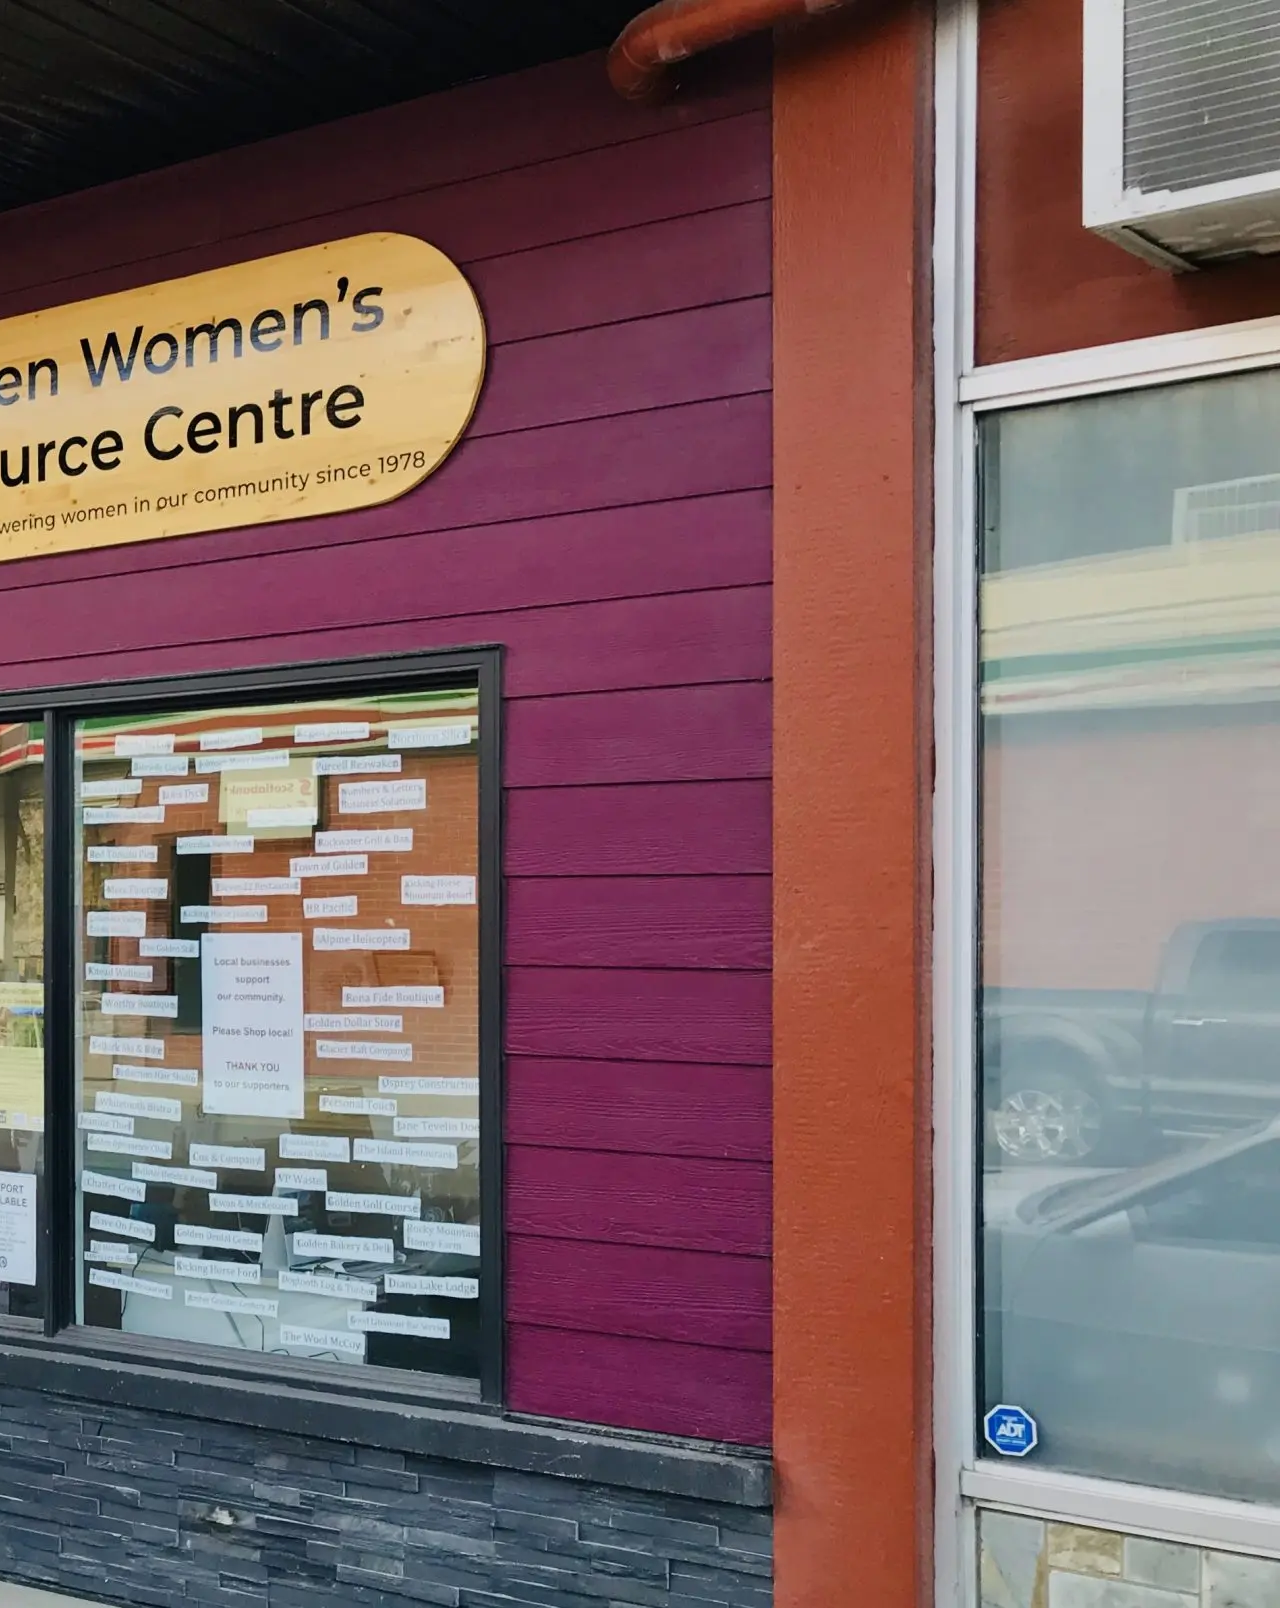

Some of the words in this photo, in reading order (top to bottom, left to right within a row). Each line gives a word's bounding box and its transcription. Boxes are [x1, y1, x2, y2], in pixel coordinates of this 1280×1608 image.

[79, 276, 385, 387] Women's
[144, 384, 365, 461] Centre
[61, 501, 128, 525] women
[134, 496, 151, 513] in
[156, 491, 188, 510] our
[194, 470, 310, 504] community
[316, 460, 371, 485] since
[378, 450, 426, 474] 1978
[391, 730, 439, 744] Northern
[315, 759, 348, 771] Purcell
[294, 861, 318, 873] Town
[321, 859, 331, 871] of
[333, 858, 365, 870] Golden
[306, 903, 320, 913] HR
[322, 901, 354, 913] Pacific
[319, 933, 350, 946] Alpine
[352, 932, 408, 945] Helicopters
[213, 957, 239, 967] Local
[240, 957, 291, 967] businesses
[235, 976, 270, 986] support
[217, 993, 232, 1001] our
[234, 993, 286, 1004] community.
[396, 992, 440, 1005] Boutique
[307, 1018, 341, 1028] Golden
[344, 1018, 371, 1028] Dollar
[374, 1018, 401, 1028] Store
[212, 1026, 241, 1036] Please
[243, 1027, 266, 1038] Shop
[268, 1027, 294, 1037] local!
[225, 1062, 258, 1072] THANK
[260, 1062, 280, 1072] YOU
[213, 1080, 223, 1088] to
[242, 1080, 290, 1091] supporters
[381, 1079, 416, 1090] Osprey
[322, 1097, 364, 1109] Personal
[367, 1099, 396, 1112] Touch
[211, 1153, 218, 1162] &
[327, 1197, 361, 1209] Golden
[362, 1199, 382, 1210] Golf
[384, 1201, 419, 1213] Course
[177, 1228, 204, 1239] Golden
[406, 1223, 434, 1236] Rocky
[297, 1239, 328, 1249] Golden
[330, 1240, 361, 1253] Bakery
[363, 1242, 370, 1251] &
[176, 1259, 209, 1274] Kicking
[211, 1264, 235, 1277] Horse
[237, 1267, 258, 1280] Ford
[388, 1278, 417, 1290] Diana
[420, 1280, 443, 1291] Lake
[445, 1281, 476, 1294] Lodge
[283, 1331, 301, 1342] The
[303, 1333, 328, 1345] Wool
[330, 1336, 361, 1350] McCoy
[996, 1423, 1025, 1438] ADT
